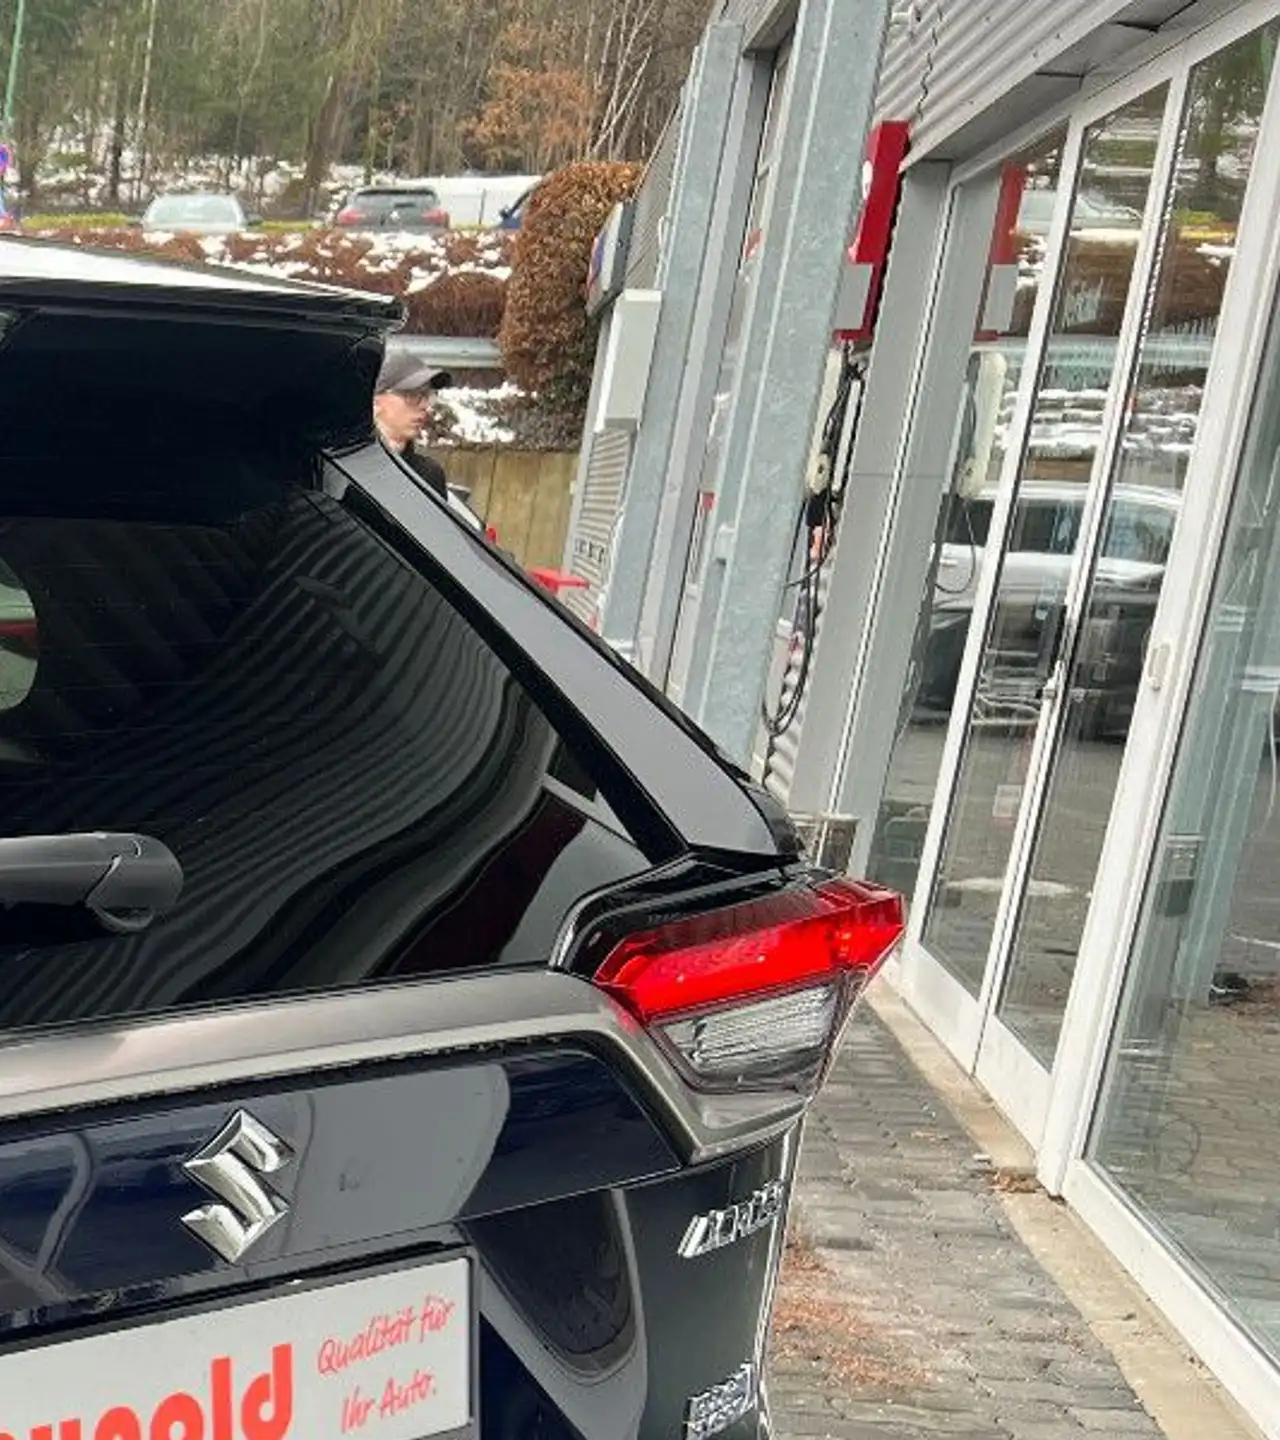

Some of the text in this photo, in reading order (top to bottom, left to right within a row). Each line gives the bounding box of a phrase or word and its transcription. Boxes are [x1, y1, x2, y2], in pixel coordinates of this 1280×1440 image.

[318, 1292, 456, 1375] Qualität für
[340, 1385, 376, 1434] Ihr
